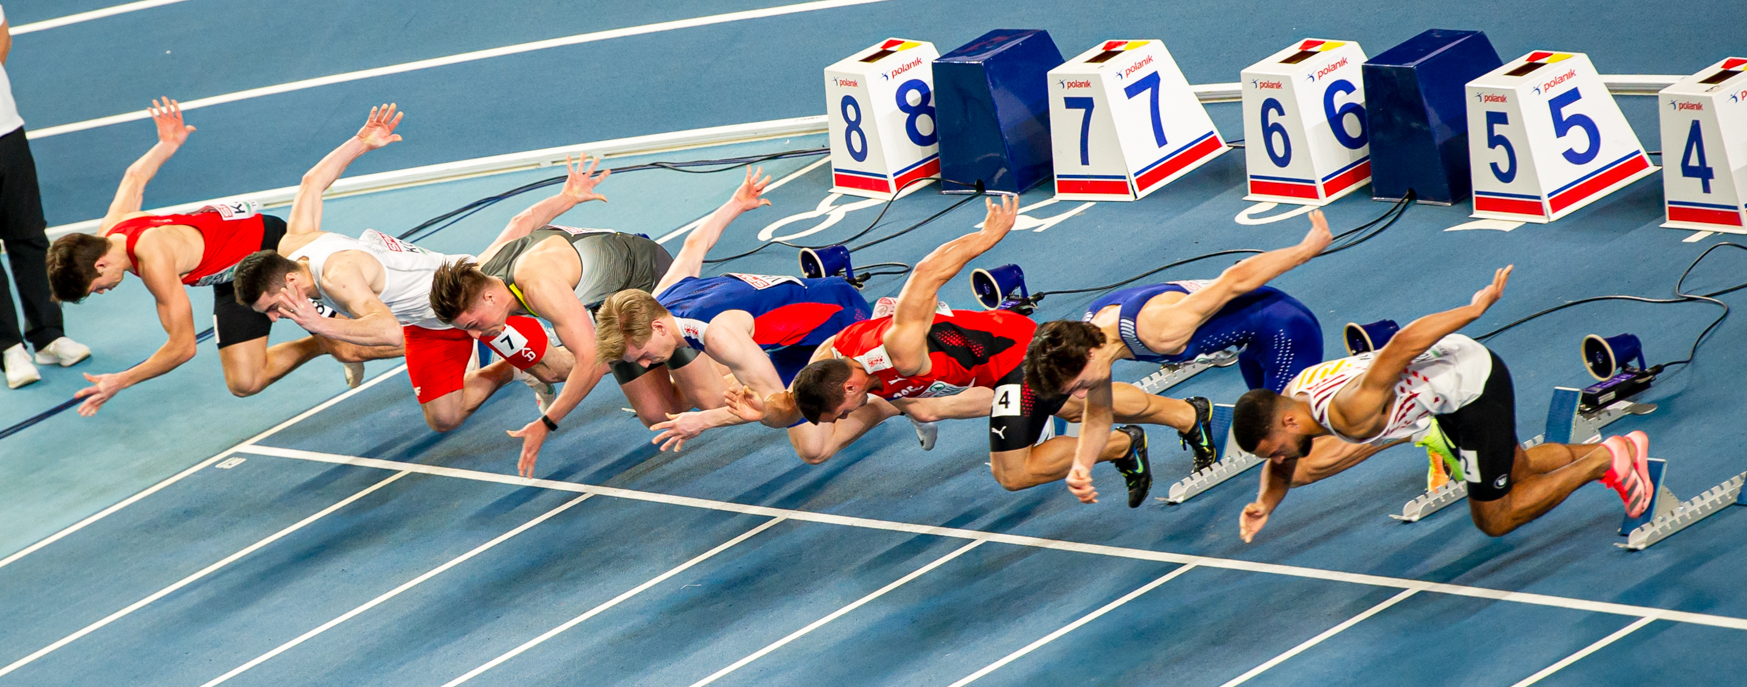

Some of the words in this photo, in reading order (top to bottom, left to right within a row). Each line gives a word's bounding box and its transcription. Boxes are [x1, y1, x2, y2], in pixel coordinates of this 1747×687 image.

[891, 57, 922, 79] polanik
[1125, 55, 1154, 78] polanik
[1317, 56, 1349, 80] polanik
[1067, 79, 1092, 90] polanik
[1259, 80, 1283, 90] polanik
[1543, 68, 1577, 92] polanik
[1123, 70, 1168, 149] 7
[1483, 93, 1508, 103] polanik
[1678, 101, 1704, 112] polanik
[895, 78, 938, 147] 8
[1323, 79, 1369, 150] 6
[841, 95, 868, 163] 8
[1063, 96, 1095, 166] 7
[1260, 97, 1292, 169] 6
[1547, 86, 1602, 166] 5
[1485, 110, 1518, 184] 5
[1680, 119, 1715, 195] 4
[499, 334, 515, 350] 7
[998, 390, 1011, 409] 4
